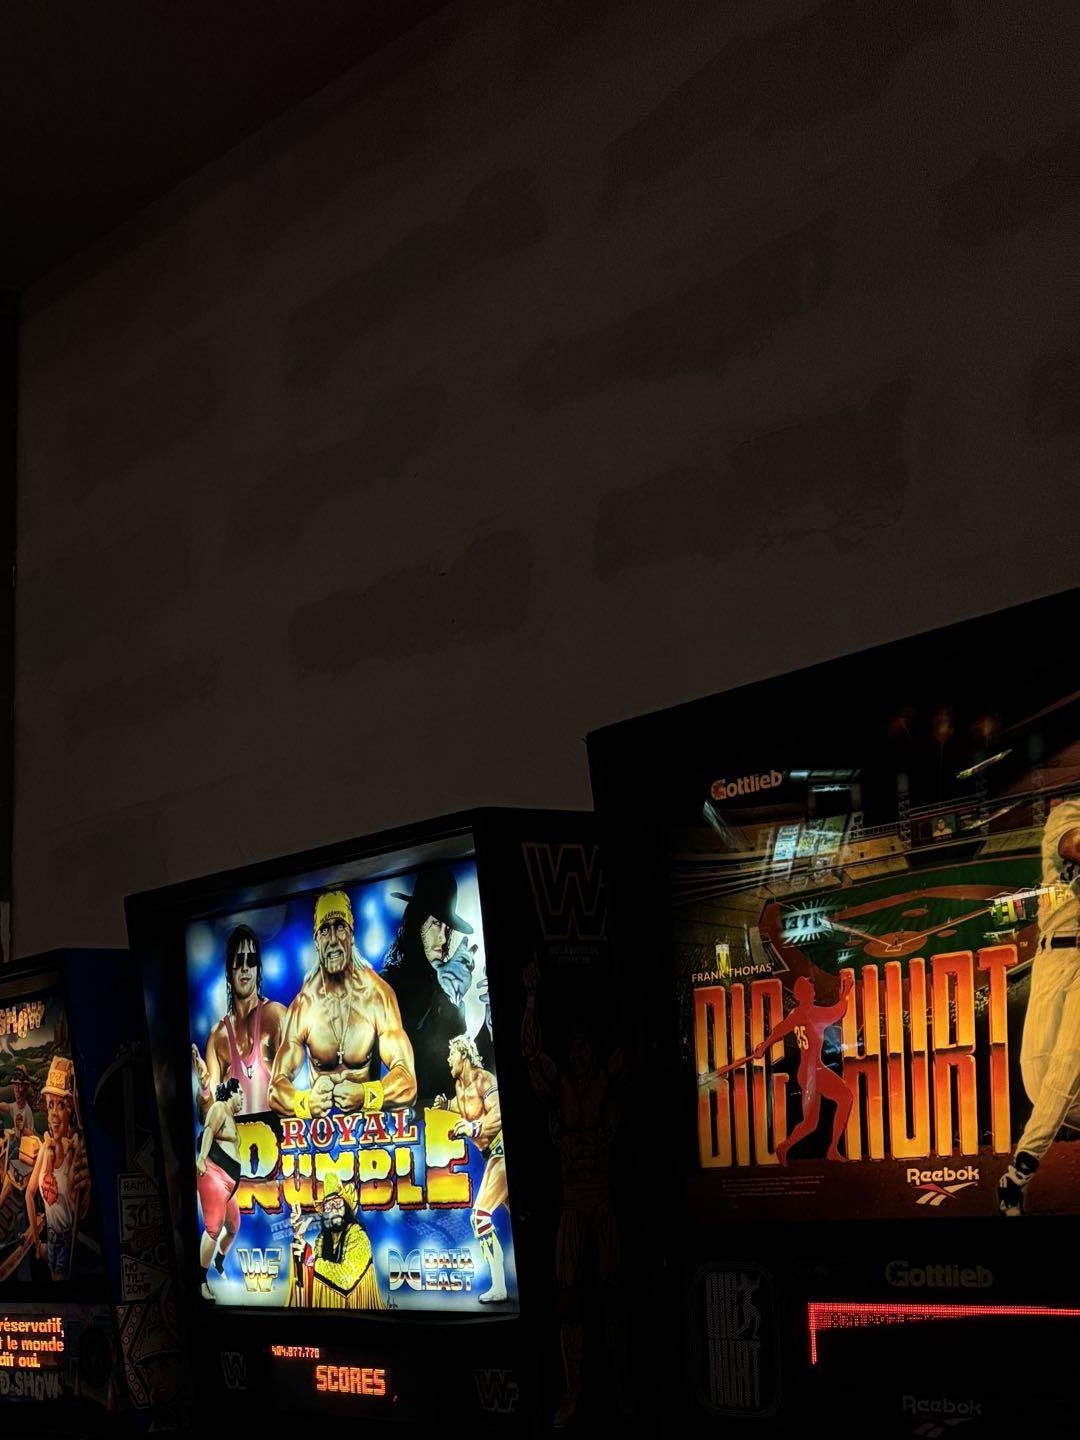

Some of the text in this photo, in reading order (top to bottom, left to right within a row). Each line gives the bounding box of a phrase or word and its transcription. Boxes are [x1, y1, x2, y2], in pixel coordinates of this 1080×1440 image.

[710, 770, 782, 800] Gottlieb
[691, 967, 727, 984] FRANK
[794, 1025, 809, 1051] 35
[694, 944, 1018, 1169] BIG HURT
[281, 1107, 418, 1151] ROYAL
[235, 1106, 473, 1214] RUMBLE
[906, 1165, 980, 1184] Reebok
[424, 1248, 475, 1271] DATA
[424, 1271, 475, 1292] EAST
[885, 1259, 995, 1290] Gottlieb
[6, 1335, 19, 1350] le
[21, 1335, 65, 1352] monde
[18, 1352, 41, 1368] oui.
[315, 1364, 386, 1396] SCORES
[900, 1393, 984, 1416] Reebok
